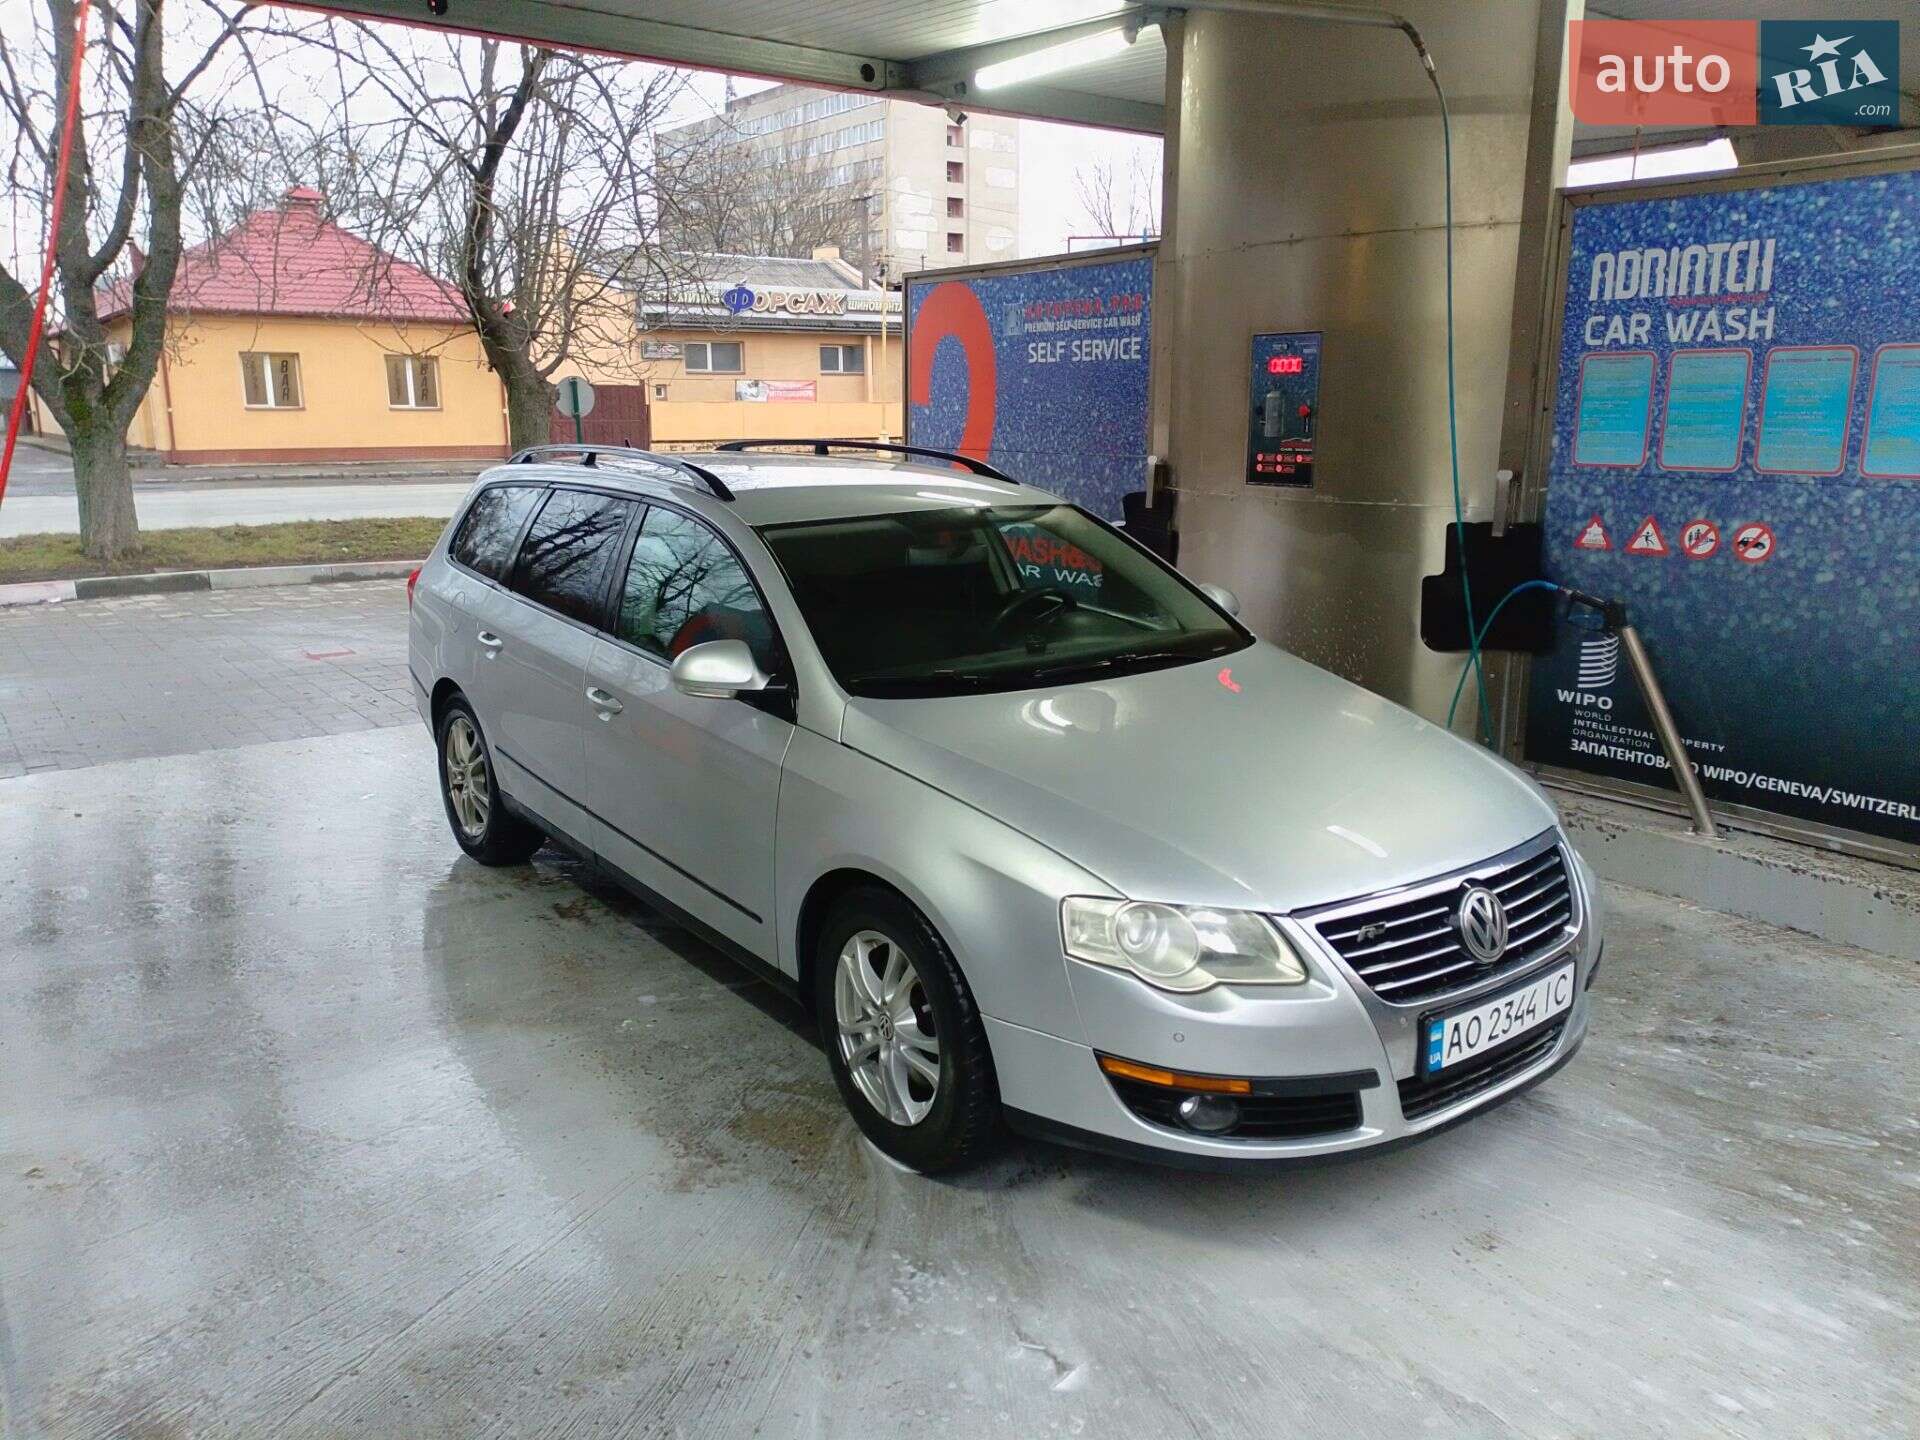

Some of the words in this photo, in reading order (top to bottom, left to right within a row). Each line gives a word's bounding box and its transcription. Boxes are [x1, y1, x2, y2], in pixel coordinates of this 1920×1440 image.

[723, 284, 846, 316] ФОРСАЖ
[1584, 312, 1652, 346] CAR
[1666, 307, 1776, 343] WASH
[1028, 341, 1066, 364] SELF
[1071, 337, 1142, 362] SERVICE
[1556, 688, 1614, 711] WIPO
[1574, 709, 1612, 722] WORLD
[1572, 728, 1652, 750] ORGANIZATION
[1573, 718, 1656, 741] INTELLECTUAL
[1703, 763, 1920, 821] WIPO/GENEVA/SWITZERL
[1447, 1016, 1482, 1059] AO
[1488, 989, 1537, 1042] 2344
[1545, 973, 1568, 1013] IC
[1429, 1053, 1442, 1065] UA
